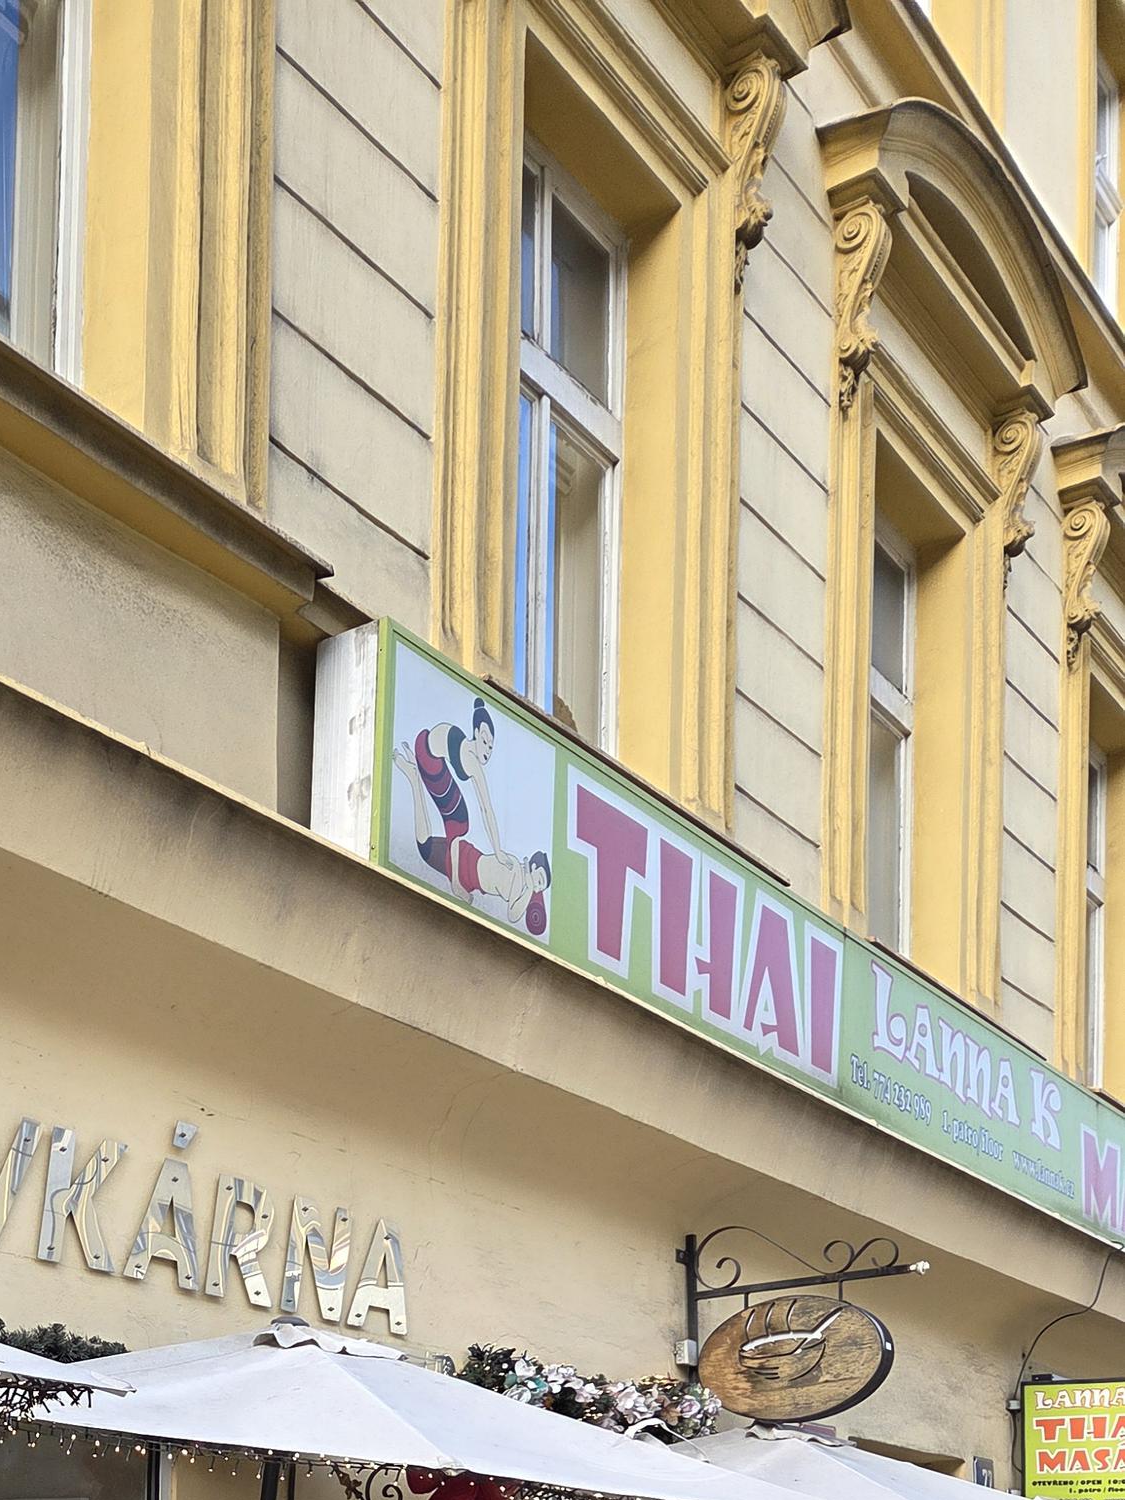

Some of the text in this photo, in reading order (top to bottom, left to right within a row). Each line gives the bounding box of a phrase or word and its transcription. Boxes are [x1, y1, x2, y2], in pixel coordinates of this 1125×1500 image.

[572, 772, 841, 1082] THAI
[850, 1055, 871, 1091] Tel.
[892, 1081, 913, 1114] 232
[941, 1109, 952, 1136] 1.
[871, 960, 1063, 1152] LANNA K
[1082, 1126, 1125, 1237] M
